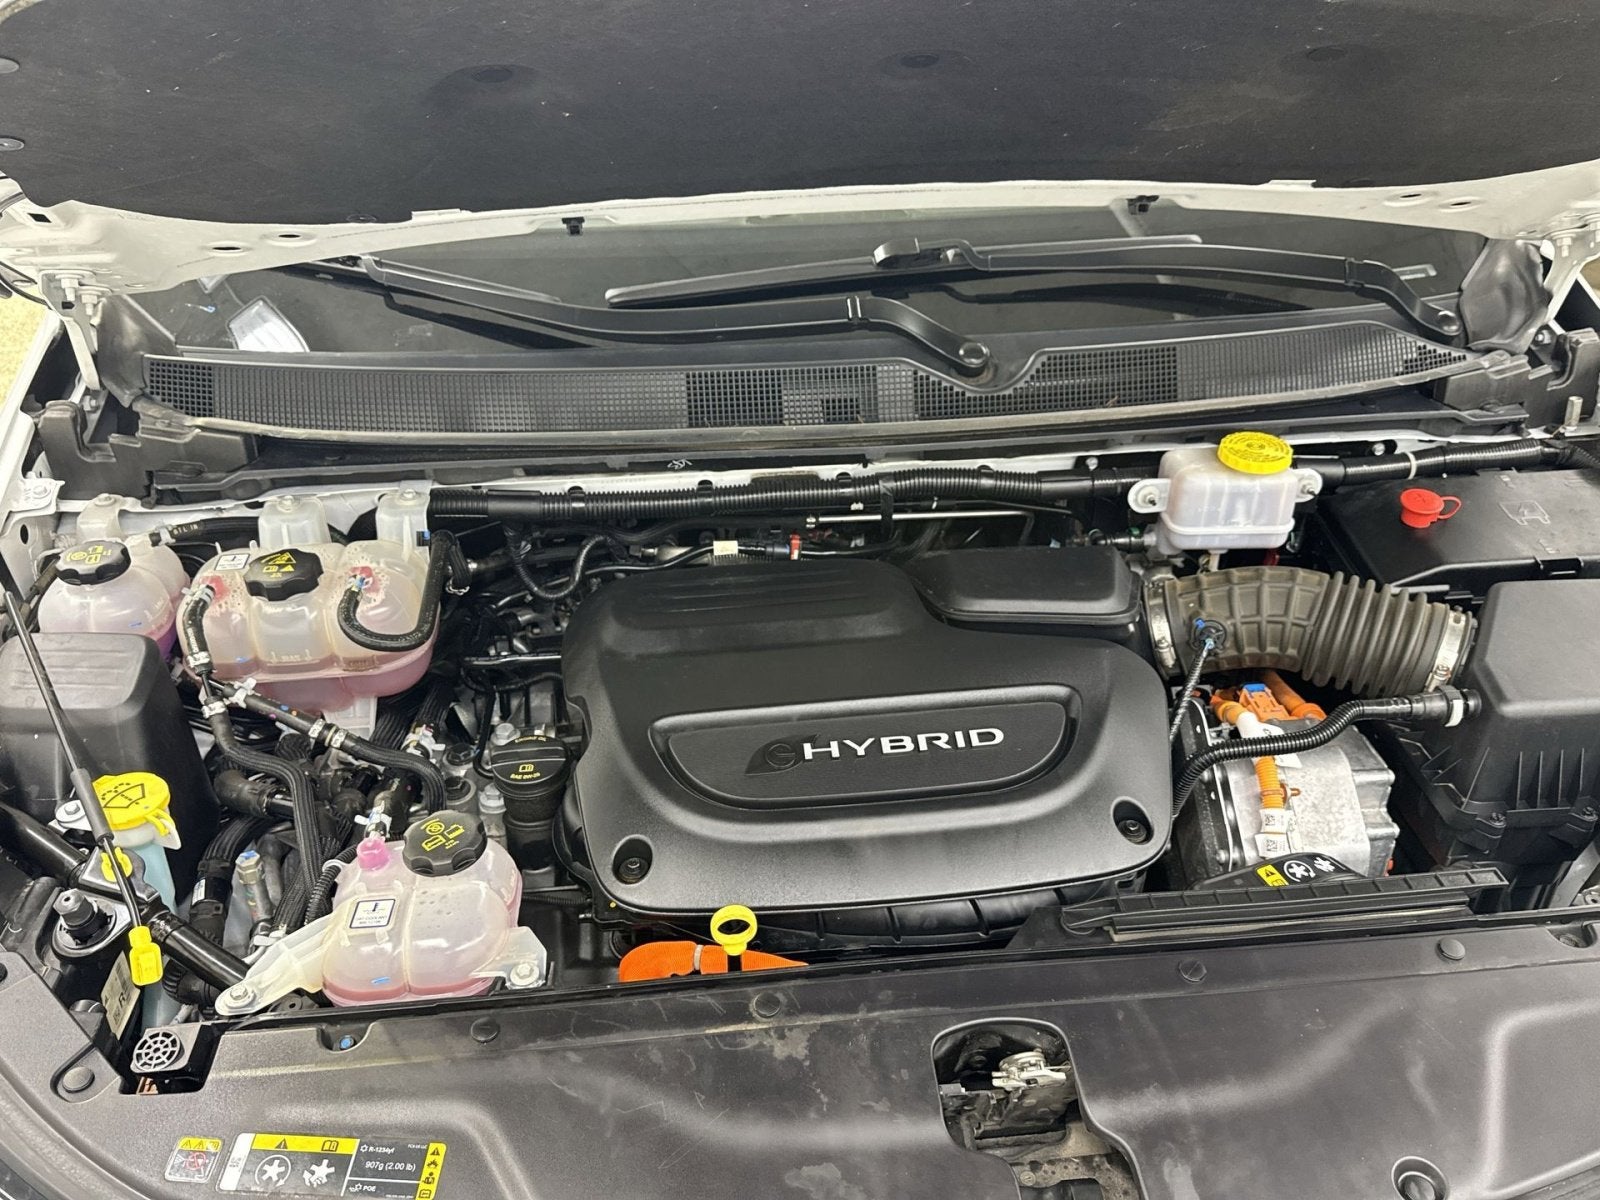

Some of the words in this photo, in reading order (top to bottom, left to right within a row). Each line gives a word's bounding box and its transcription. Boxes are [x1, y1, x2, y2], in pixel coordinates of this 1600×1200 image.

[803, 727, 1005, 760] HYBRID
[365, 1160, 384, 1171] 907g
[385, 1162, 404, 1171] (2.00
[406, 1162, 416, 1172] lb)
